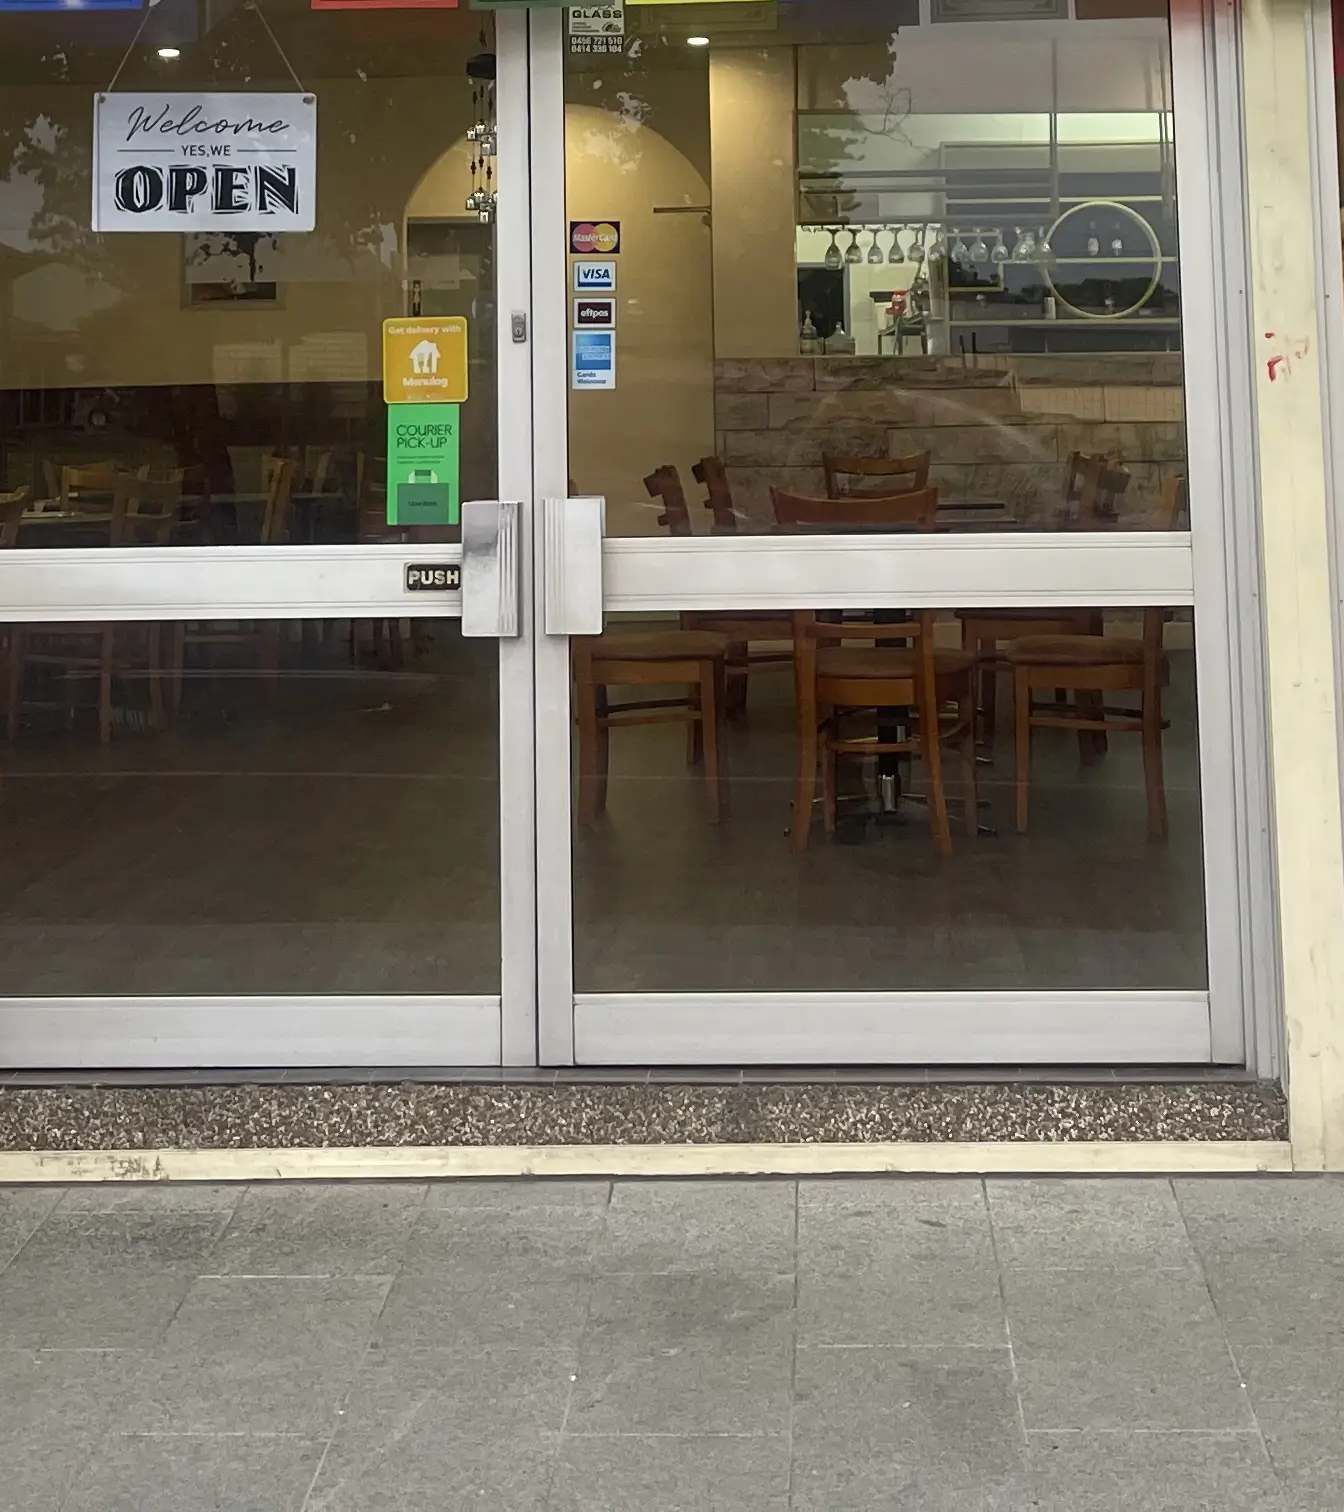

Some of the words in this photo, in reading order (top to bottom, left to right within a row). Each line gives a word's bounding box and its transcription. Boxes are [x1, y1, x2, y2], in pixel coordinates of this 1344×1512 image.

[572, 9, 622, 19] GLASS
[126, 103, 290, 143] Welcome
[113, 163, 299, 215] OPEN
[582, 268, 610, 280] VISA
[396, 424, 453, 436] COURIER
[396, 436, 448, 449] PICK-UP
[408, 569, 460, 586] PUSH
